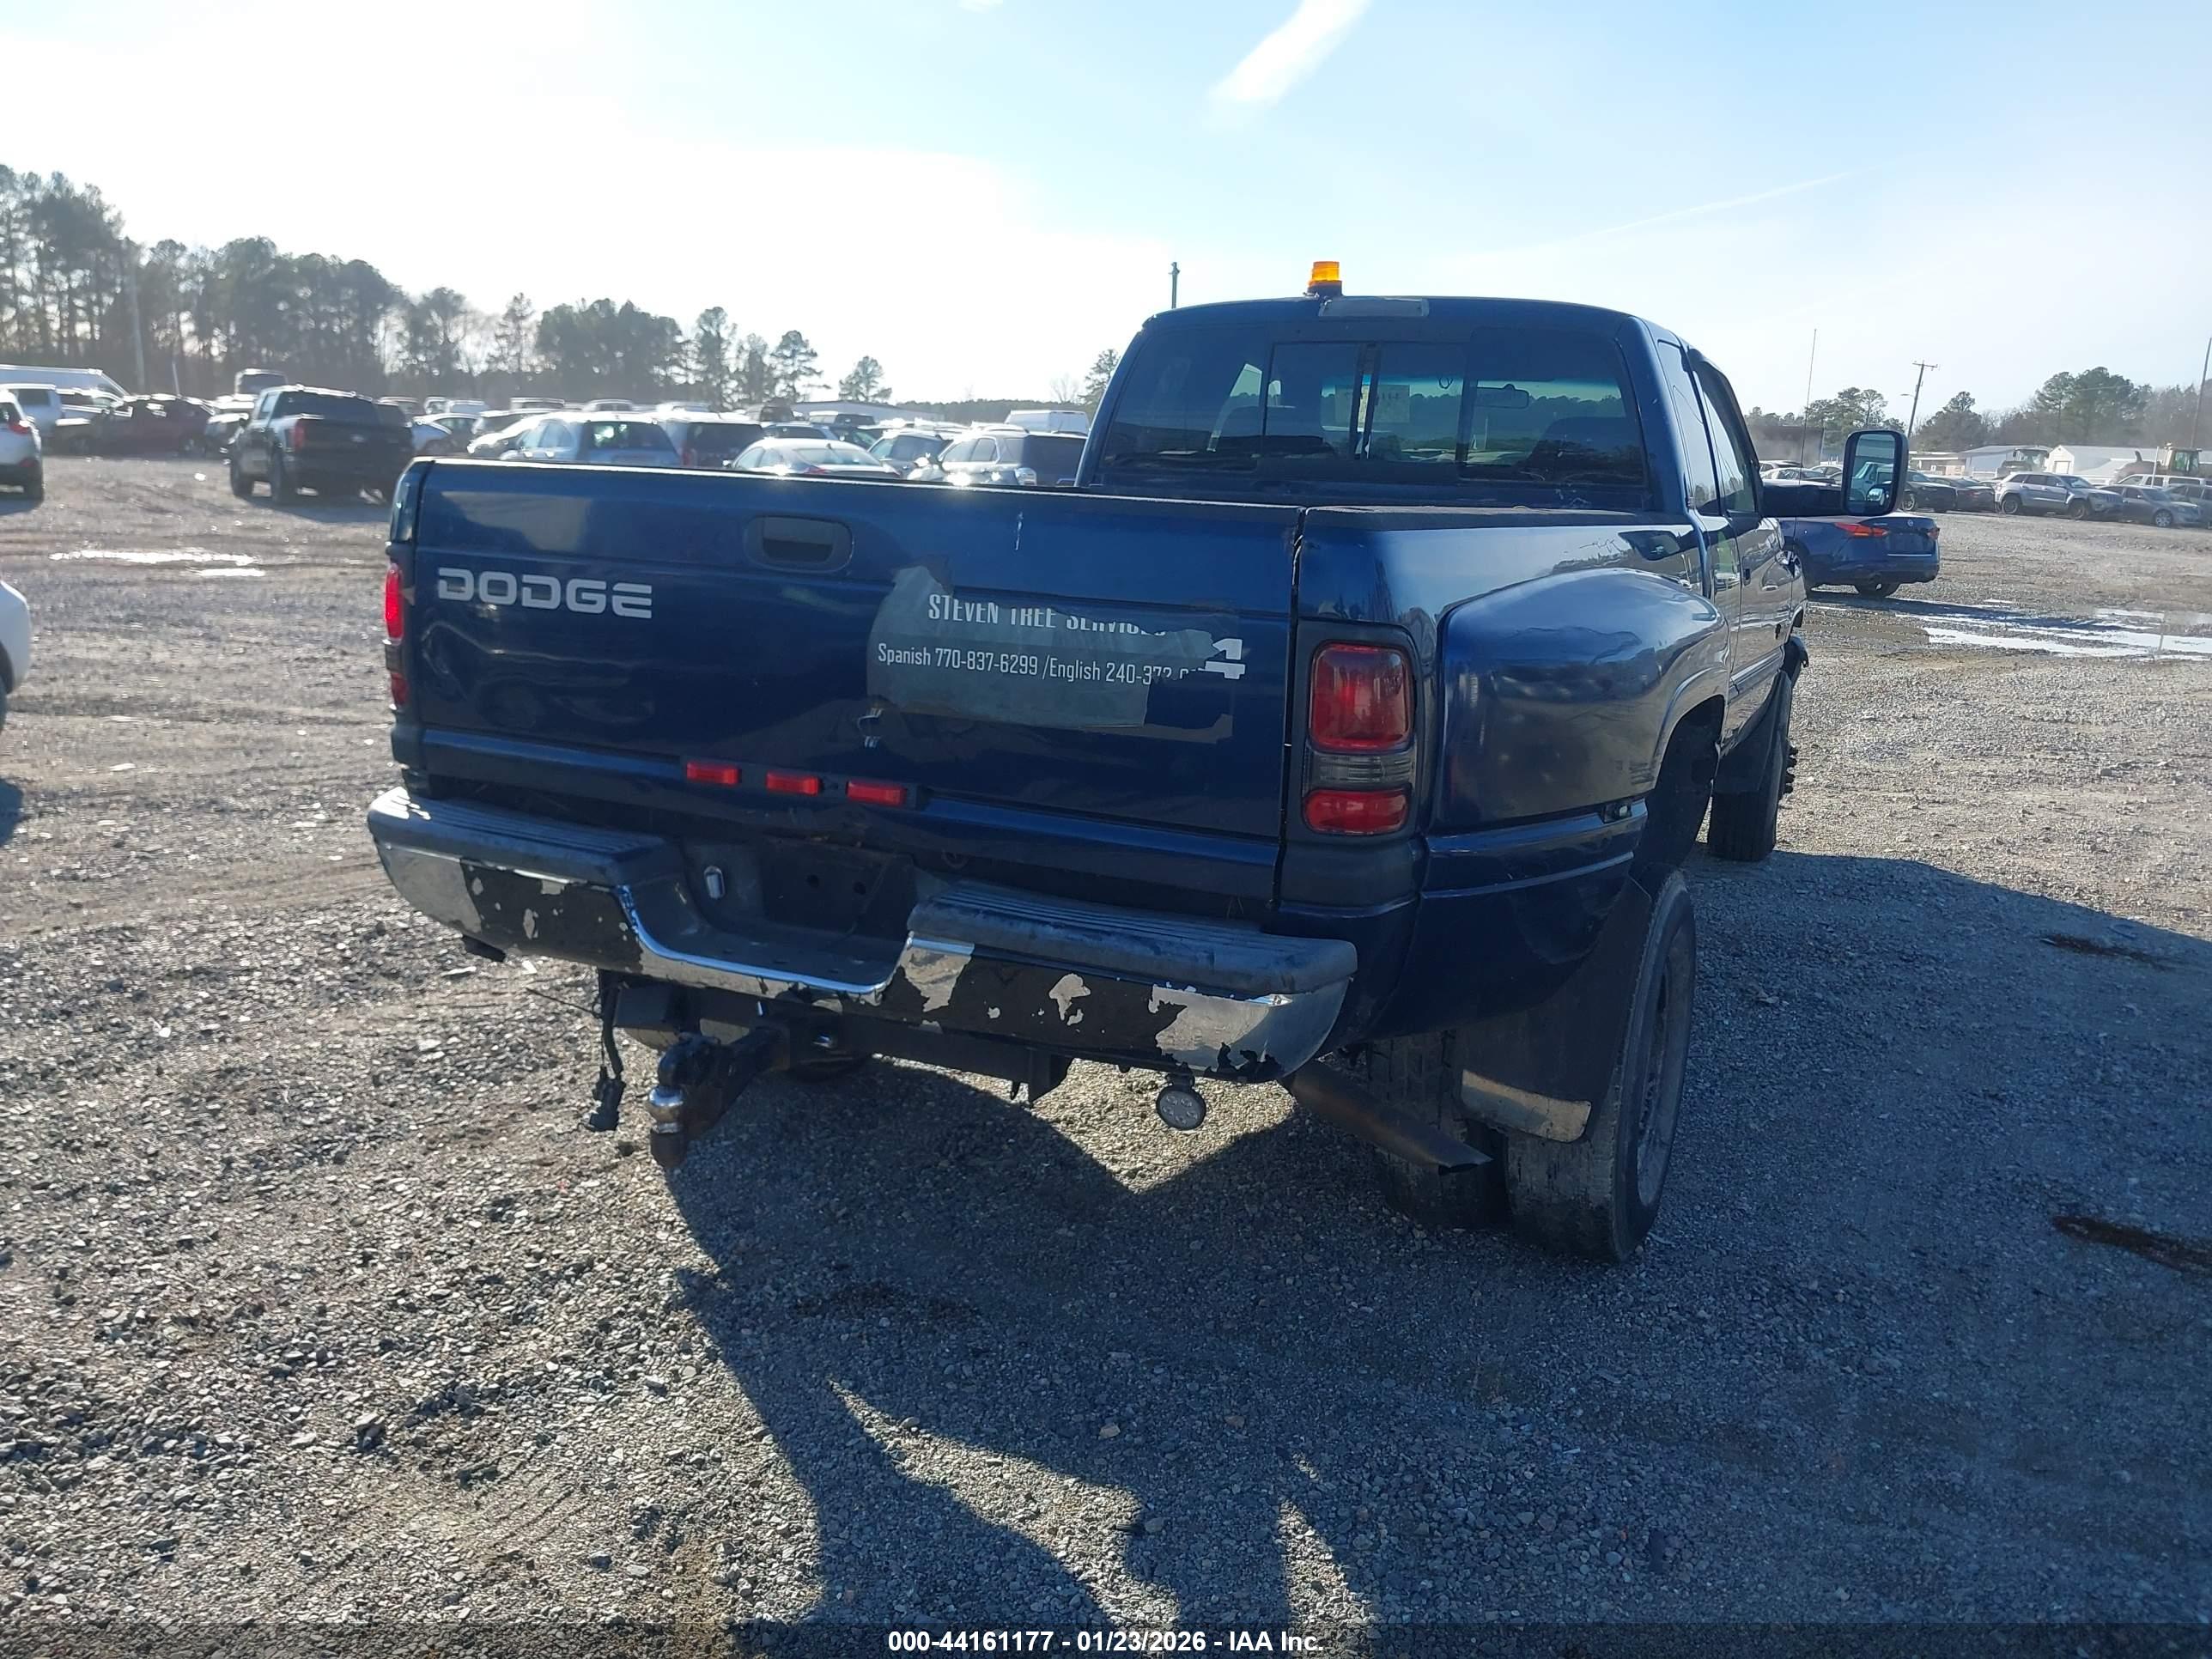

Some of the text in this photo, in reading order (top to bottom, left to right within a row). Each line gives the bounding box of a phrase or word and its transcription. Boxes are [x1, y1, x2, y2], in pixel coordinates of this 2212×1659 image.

[438, 567, 653, 619] DODGE
[928, 593, 999, 624] STEVEN
[878, 642, 931, 666] Spanish
[934, 647, 1038, 675] 770-837-6299
